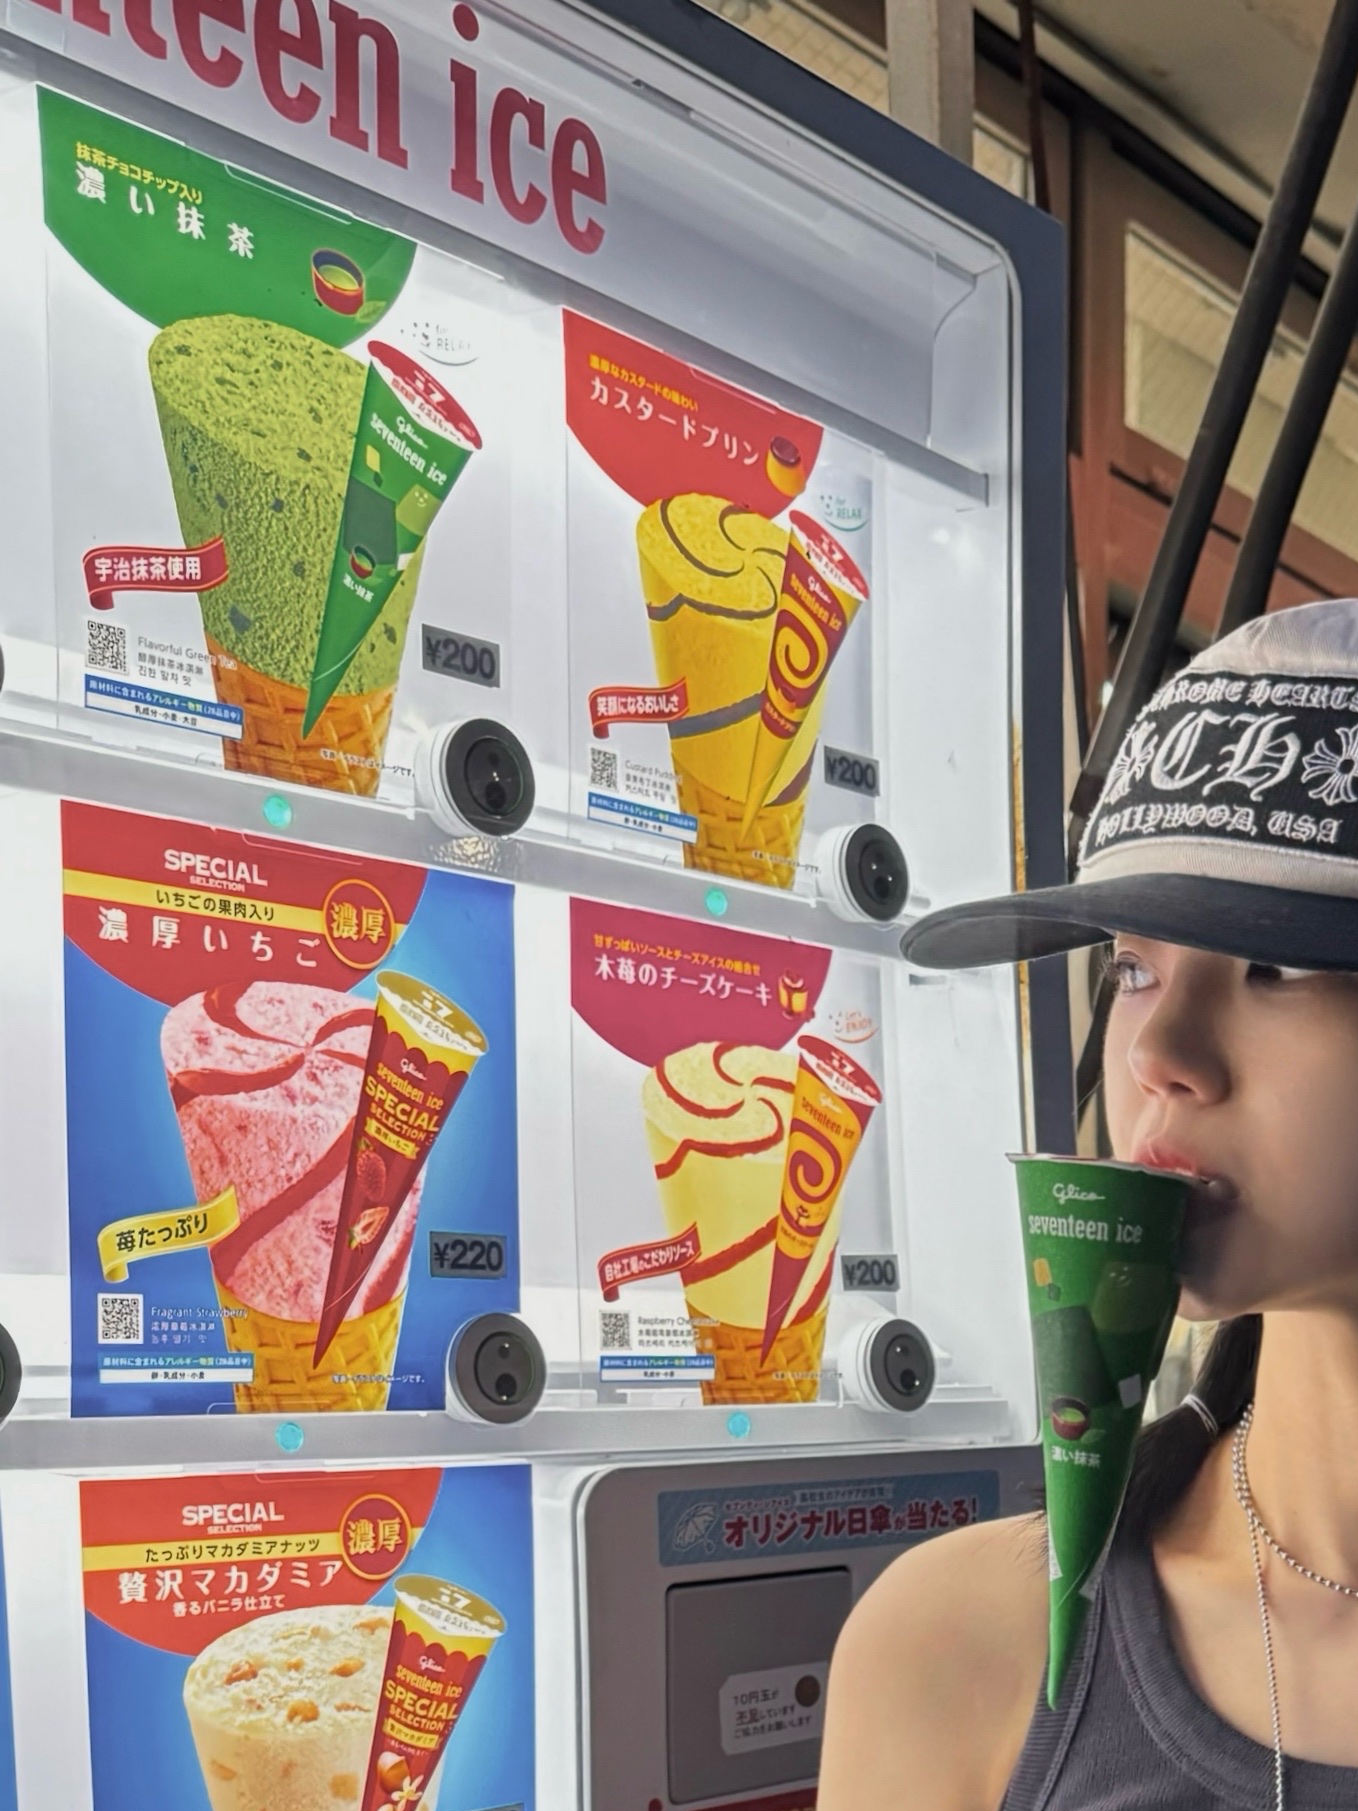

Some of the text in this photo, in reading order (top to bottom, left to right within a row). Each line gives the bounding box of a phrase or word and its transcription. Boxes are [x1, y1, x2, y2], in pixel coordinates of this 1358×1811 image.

[451, 3, 607, 255] ice
[76, 141, 203, 204] 抹茶チョコチップ入り
[76, 160, 255, 259] 濃い抹茶
[591, 376, 759, 465] カスタードプリン
[370, 412, 447, 486] seventeen ice
[836, 508, 863, 520] RELAX
[94, 556, 202, 582] 宇治抹茶使用
[138, 636, 183, 657] Flavorful
[185, 648, 217, 666] Green
[425, 636, 496, 680] ¥200
[597, 694, 680, 716] 笑顔になるおいしさ
[1150, 708, 1301, 802] CH
[826, 756, 877, 791] ¥200
[1267, 810, 1343, 844] USA
[164, 848, 268, 887] SPECIAL
[189, 875, 246, 893] SELECTION
[156, 889, 275, 921] いちごの果肉入り
[98, 905, 320, 968] 濃厚いちご
[330, 901, 387, 945] 濃厚
[595, 953, 773, 1007] 木苺のチーズケーキ
[365, 1074, 441, 1132] SPECIAL
[377, 1062, 445, 1111] seventeen ice
[369, 1102, 426, 1142] SELECTION
[801, 1096, 842, 1135] seventeen
[1052, 1183, 1106, 1203] Glico
[116, 1213, 208, 1253] 苺たっぷり
[1028, 1213, 1143, 1244] seventeen ice
[433, 1239, 504, 1272] ¥220
[605, 1241, 695, 1282] 自社工場のこだわりソース
[843, 1259, 896, 1287] ¥200
[151, 1307, 192, 1320] Fragrant
[1051, 1446, 1101, 1468] 濃い抹茶
[182, 1501, 284, 1526] SPECIAL
[207, 1523, 263, 1535] SELECTION
[724, 1497, 978, 1548] オリジナル日傘が当たる!
[145, 1538, 320, 1563] たっぷりマカダミアナッツ
[347, 1518, 402, 1555] 濃厚
[118, 1560, 343, 1605] 贅沢マカダミア
[173, 1594, 286, 1618] 香るバニラ仕立て
[396, 1665, 463, 1698] seventeen ice
[733, 1689, 780, 1706] 10円玉が
[384, 1679, 459, 1720] SPECIAL
[734, 1704, 796, 1724] 不足しています
[389, 1705, 445, 1732] SELECTION
